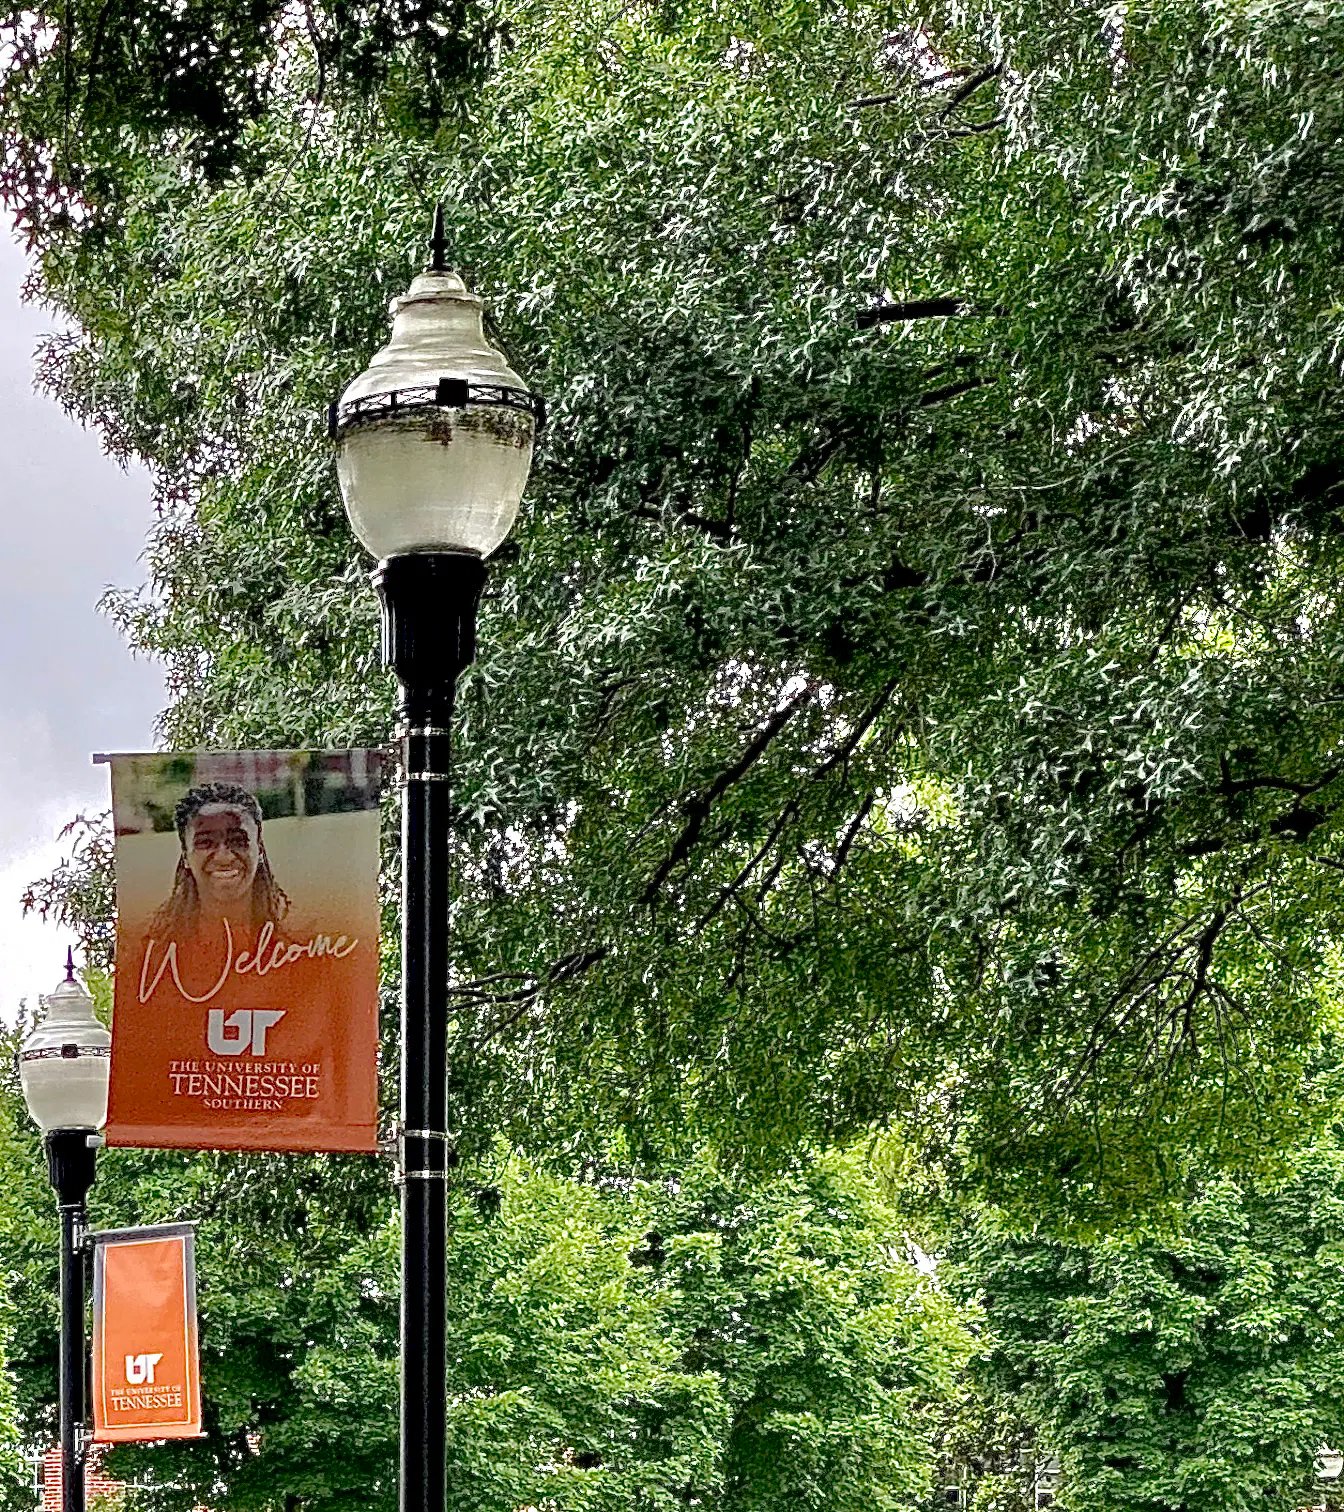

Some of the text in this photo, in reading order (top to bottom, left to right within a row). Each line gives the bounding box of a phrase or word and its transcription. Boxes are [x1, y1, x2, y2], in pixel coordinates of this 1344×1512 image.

[135, 917, 360, 1003] Welcome
[207, 1008, 287, 1056] UT
[169, 1060, 321, 1075] THE UNIVERSITY OF
[168, 1073, 321, 1098] TENNESSEE
[202, 1098, 284, 1110] SOUTHERN
[124, 1352, 164, 1385] UT
[111, 1393, 183, 1411] TENNESSEE
